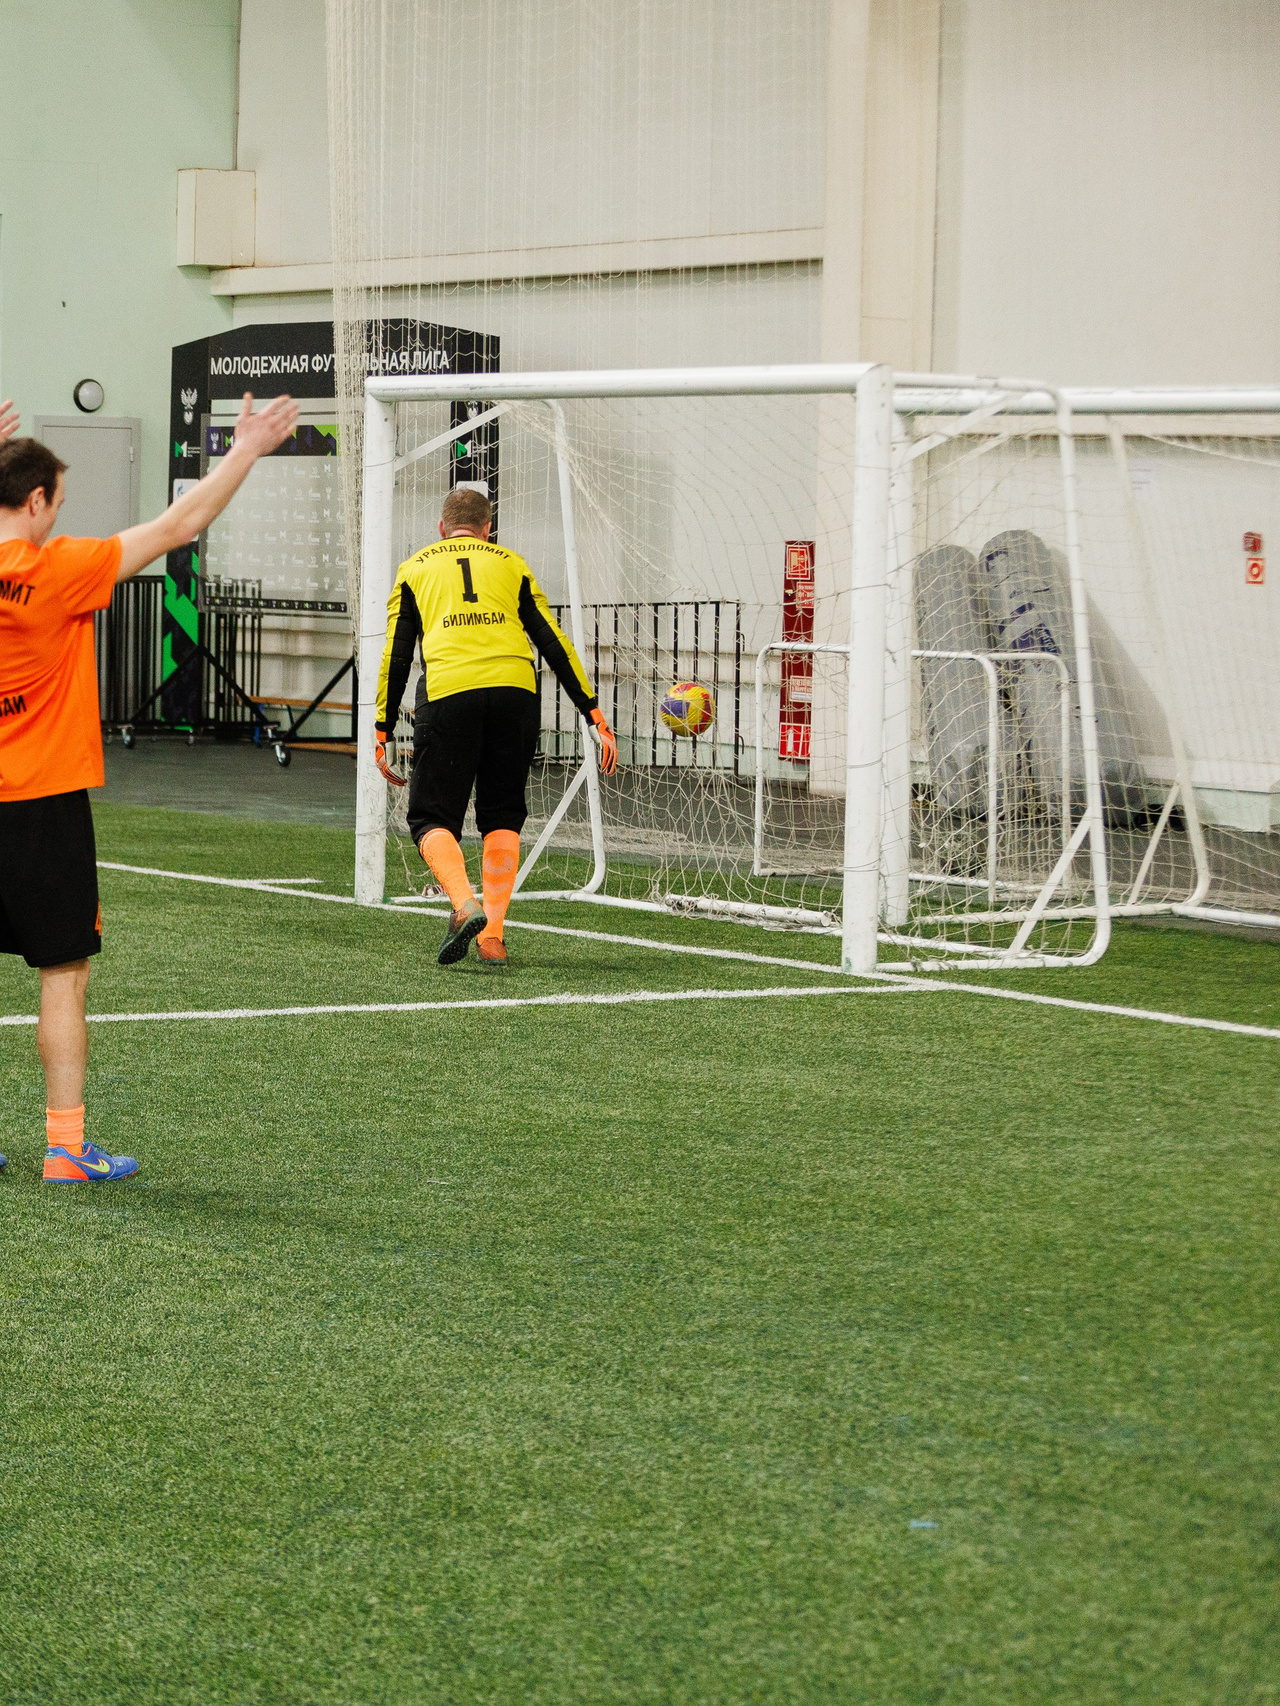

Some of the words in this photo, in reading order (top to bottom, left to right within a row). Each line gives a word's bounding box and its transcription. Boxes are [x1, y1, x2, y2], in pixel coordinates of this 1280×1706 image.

[210, 354, 309, 377] МОЛОДЕЖНАЯ
[311, 351, 410, 373] ФУБОЛЬНАЯ
[411, 350, 450, 370] ЛИГА
[415, 543, 511, 564] УРАЛДОЛОМИТ
[456, 557, 479, 604] 1
